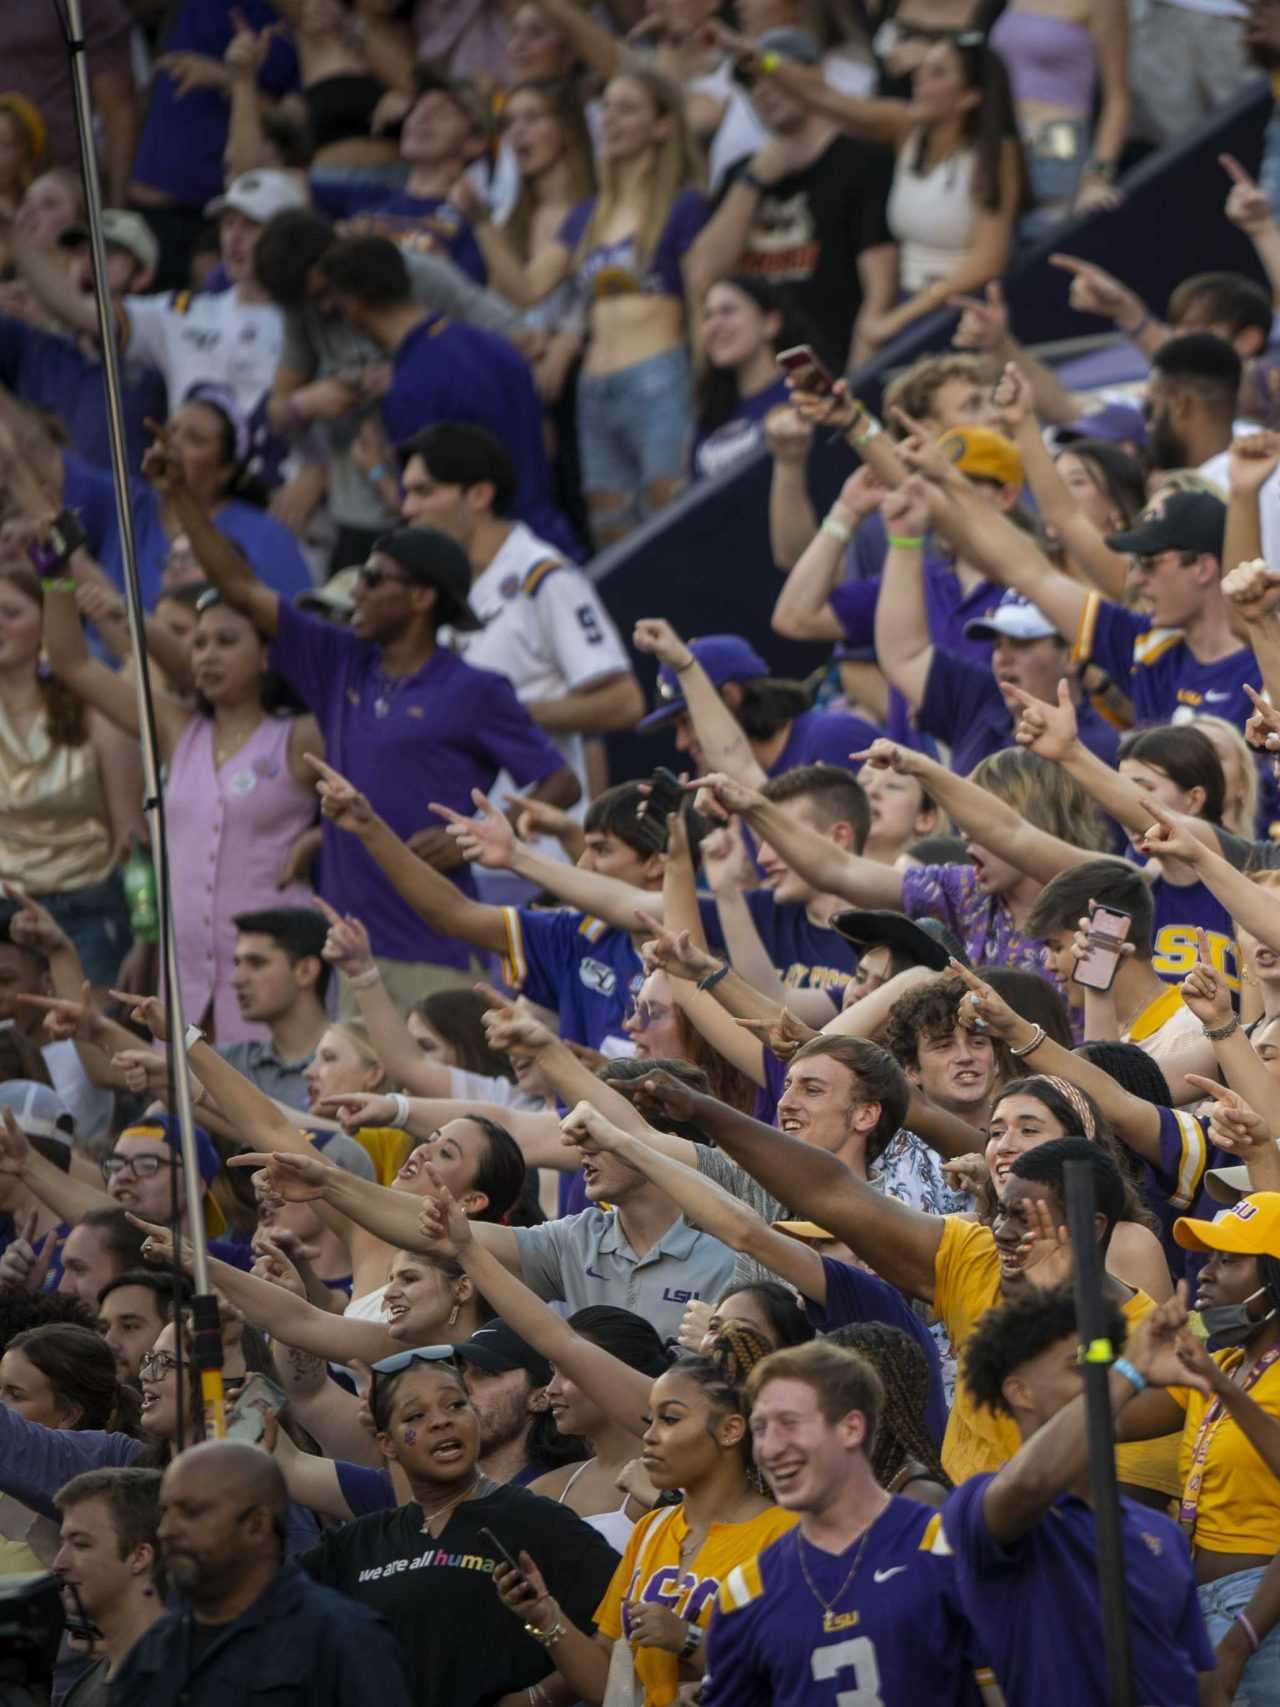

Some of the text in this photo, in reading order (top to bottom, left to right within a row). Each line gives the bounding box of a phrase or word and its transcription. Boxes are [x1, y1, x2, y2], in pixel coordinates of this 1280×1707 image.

[358, 1548, 496, 1583] we are all huma
[823, 1610, 859, 1632] LSU
